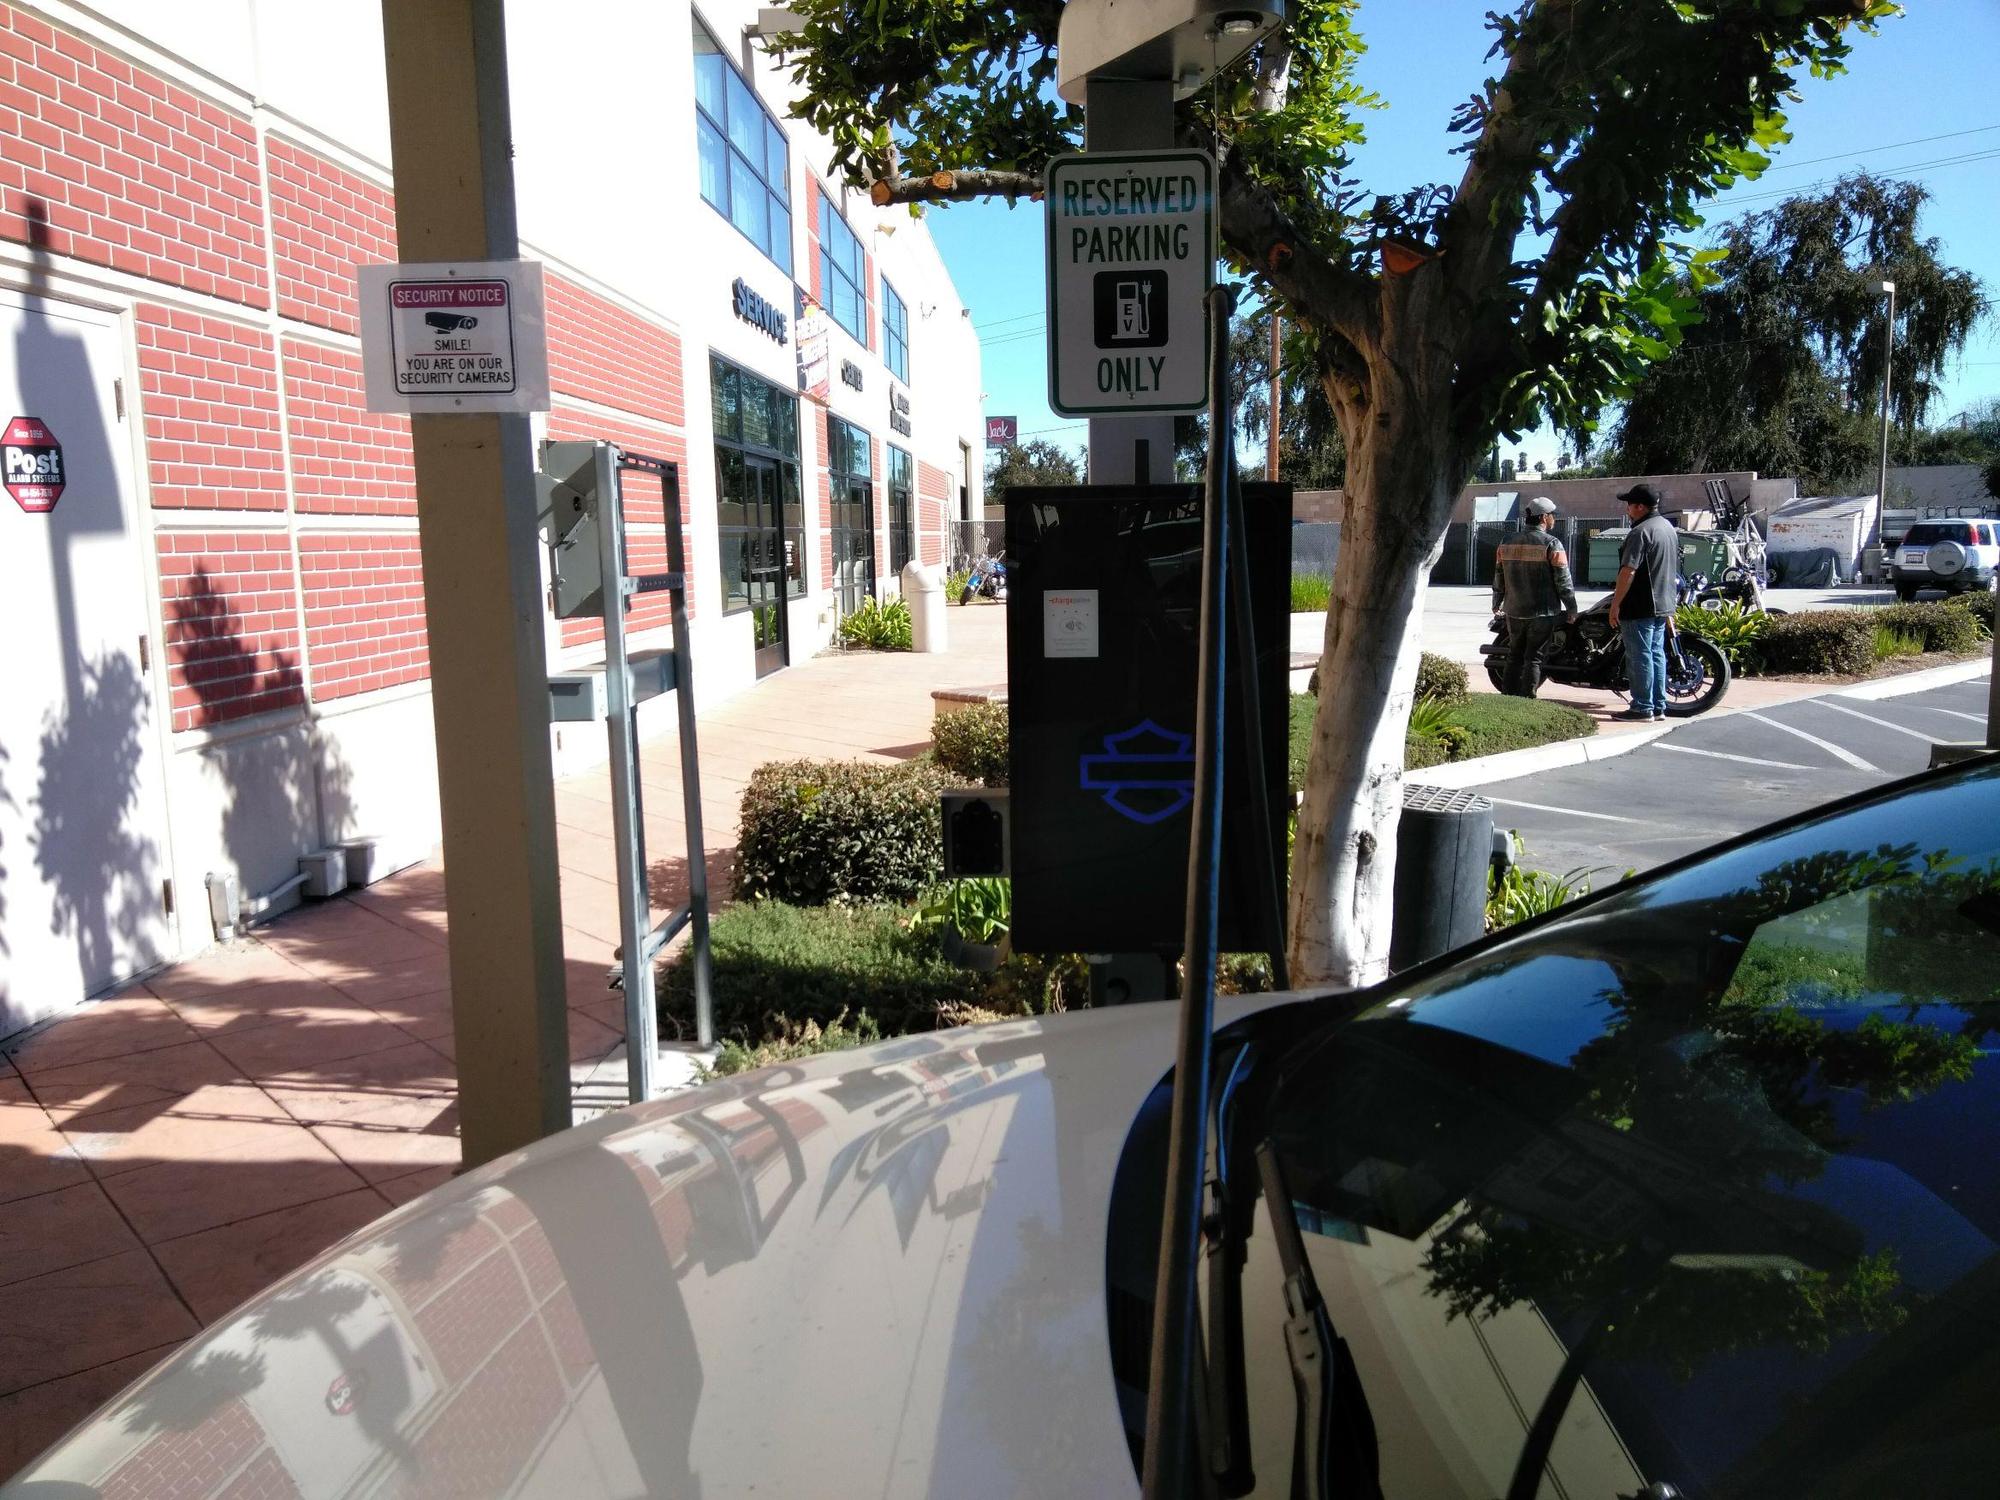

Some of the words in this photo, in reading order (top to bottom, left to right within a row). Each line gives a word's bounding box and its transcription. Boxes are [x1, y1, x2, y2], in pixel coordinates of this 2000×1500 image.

[1063, 175, 1197, 217] RESERVED
[1072, 223, 1189, 263] PARKING
[397, 289, 454, 303] SECURITY
[459, 288, 502, 302] NOTICE
[732, 276, 788, 347] SERVICE
[435, 339, 471, 351] SMILE!
[406, 359, 429, 370] YOU
[433, 358, 455, 370] ARE
[459, 358, 475, 370] ON
[479, 357, 503, 369] OUR
[401, 372, 454, 384] SECURITY
[457, 371, 511, 384] CAMERAS
[1097, 356, 1166, 393] ONLY
[988, 420, 1016, 439] Jack
[5, 446, 60, 474] Post
[8, 474, 31, 483] ALARM
[32, 474, 60, 483] SYSTEMS
